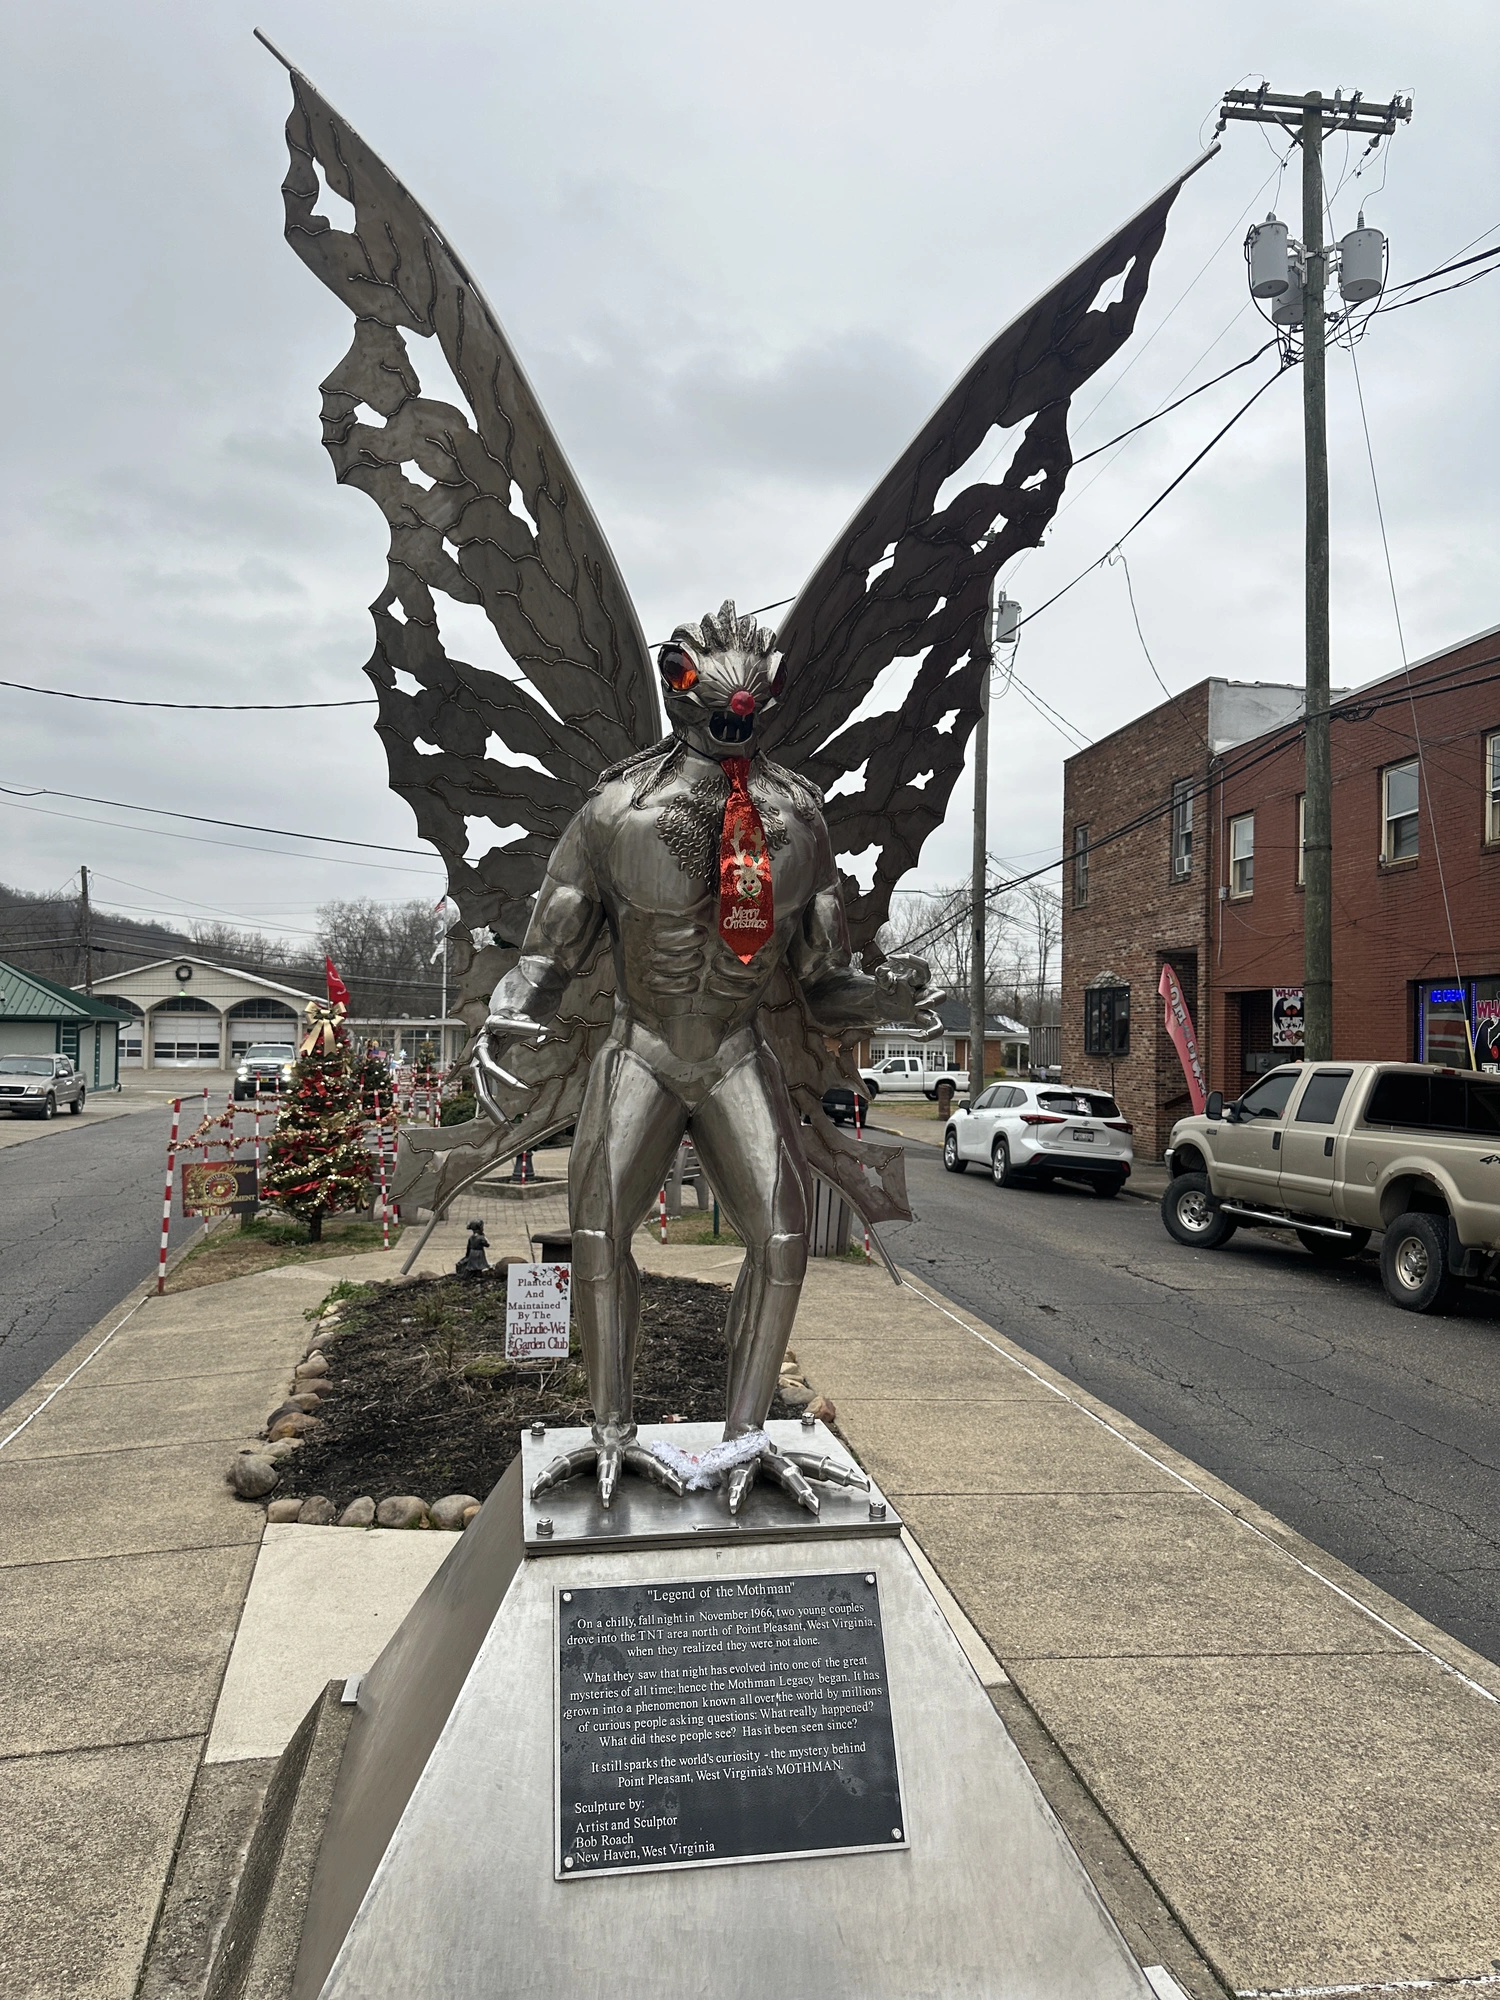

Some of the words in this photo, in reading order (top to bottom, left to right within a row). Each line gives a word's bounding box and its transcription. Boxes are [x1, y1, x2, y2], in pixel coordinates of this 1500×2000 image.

[723, 916, 768, 930] Christmas
[731, 906, 760, 919] Merry
[518, 1278, 552, 1286] Planted
[525, 1290, 544, 1298] And
[508, 1302, 560, 1310] Maintained
[518, 1312, 530, 1321] By
[532, 1311, 551, 1319] The
[510, 1322, 566, 1334] Tu-Endie-Wei
[514, 1338, 546, 1350] Garden
[548, 1336, 568, 1350] Club
[648, 1586, 695, 1603] "Legend
[700, 1586, 712, 1598] of
[716, 1586, 733, 1597] the
[737, 1582, 794, 1596] Mothman"
[578, 1619, 592, 1628] On
[606, 1616, 636, 1628] chilly,
[639, 1615, 654, 1625] fall
[658, 1614, 682, 1626] night
[686, 1612, 694, 1622] in
[699, 1608, 748, 1621] November
[751, 1608, 774, 1618] 1966,
[777, 1608, 794, 1617] two
[798, 1607, 826, 1617] young
[829, 1603, 864, 1613] couples
[567, 1635, 594, 1645] drove
[598, 1633, 617, 1643] into
[621, 1632, 635, 1641] the
[638, 1630, 664, 1640] TNT
[668, 1630, 688, 1638] area
[692, 1627, 718, 1637] north
[722, 1625, 732, 1635] of
[736, 1624, 761, 1634] Point
[763, 1622, 806, 1632] Pleasant,
[807, 1620, 830, 1630] West
[832, 1617, 876, 1630] Virginia,
[627, 1647, 653, 1657] when
[658, 1646, 678, 1656] they
[683, 1642, 722, 1653] realized
[727, 1641, 747, 1651] they
[750, 1640, 773, 1649] were
[776, 1638, 790, 1647] not
[793, 1636, 820, 1646] alone.
[583, 1672, 610, 1682] What
[614, 1671, 634, 1682] they
[638, 1671, 657, 1680] saw
[661, 1668, 679, 1678] that
[682, 1666, 708, 1679] night
[711, 1665, 727, 1676] has
[730, 1662, 765, 1674] evolved
[770, 1660, 789, 1671] into
[792, 1660, 808, 1669] one
[812, 1658, 822, 1668] of
[825, 1657, 840, 1667] the
[843, 1656, 867, 1668] great
[570, 1688, 618, 1702] mysteries
[621, 1686, 632, 1697] of
[634, 1686, 646, 1696] all
[650, 1684, 675, 1694] time;
[678, 1683, 706, 1693] hence
[710, 1681, 725, 1690] the
[728, 1678, 775, 1690] Mothman
[779, 1676, 814, 1688] Legacy
[818, 1674, 850, 1685] began.
[853, 1671, 860, 1681] It
[863, 1670, 880, 1680] has
[566, 1706, 598, 1719] grown
[603, 1704, 623, 1714] into
[636, 1699, 698, 1714] phenomenon
[702, 1696, 736, 1707] known
[740, 1694, 752, 1705] all
[755, 1694, 774, 1704] over
[778, 1692, 793, 1702] the
[796, 1689, 823, 1700] world
[827, 1688, 838, 1700] by
[842, 1686, 882, 1697] millions
[579, 1722, 590, 1732] of
[593, 1720, 631, 1731] curious
[634, 1716, 666, 1731] people
[670, 1714, 703, 1726] asking
[708, 1711, 757, 1726] questions:
[760, 1708, 786, 1720] What
[789, 1706, 817, 1718] really
[822, 1701, 873, 1716] happened?
[600, 1736, 626, 1746] What
[630, 1734, 646, 1745] did
[650, 1732, 676, 1743] these
[680, 1729, 712, 1744] people
[715, 1727, 736, 1738] see?
[743, 1726, 762, 1736] Has
[764, 1725, 770, 1734] it
[775, 1724, 797, 1734] been
[802, 1723, 823, 1732] seen
[828, 1718, 857, 1730] since?
[592, 1762, 598, 1773] It
[602, 1760, 622, 1772] still
[624, 1758, 658, 1772] sparks
[661, 1757, 676, 1767] the
[679, 1754, 714, 1766] world's
[716, 1751, 760, 1763] curiosity
[771, 1748, 786, 1758] the
[789, 1746, 828, 1759] mystery
[832, 1742, 866, 1754] behind
[618, 1776, 644, 1787] Point
[648, 1774, 693, 1785] Pleasant,
[696, 1770, 720, 1780] West
[723, 1765, 772, 1780] Virginia's
[776, 1760, 843, 1775] MOTHMAN.
[575, 1801, 625, 1814] Sculpture
[629, 1798, 644, 1812] by:
[576, 1821, 608, 1833] Artist
[612, 1818, 629, 1830] and
[634, 1816, 677, 1829] Sculptor
[576, 1836, 597, 1848] Bob
[602, 1833, 633, 1846] Roach
[576, 1852, 600, 1863] New
[604, 1849, 640, 1861] Haven,
[642, 1844, 666, 1857] West
[670, 1841, 715, 1855] Virginia
